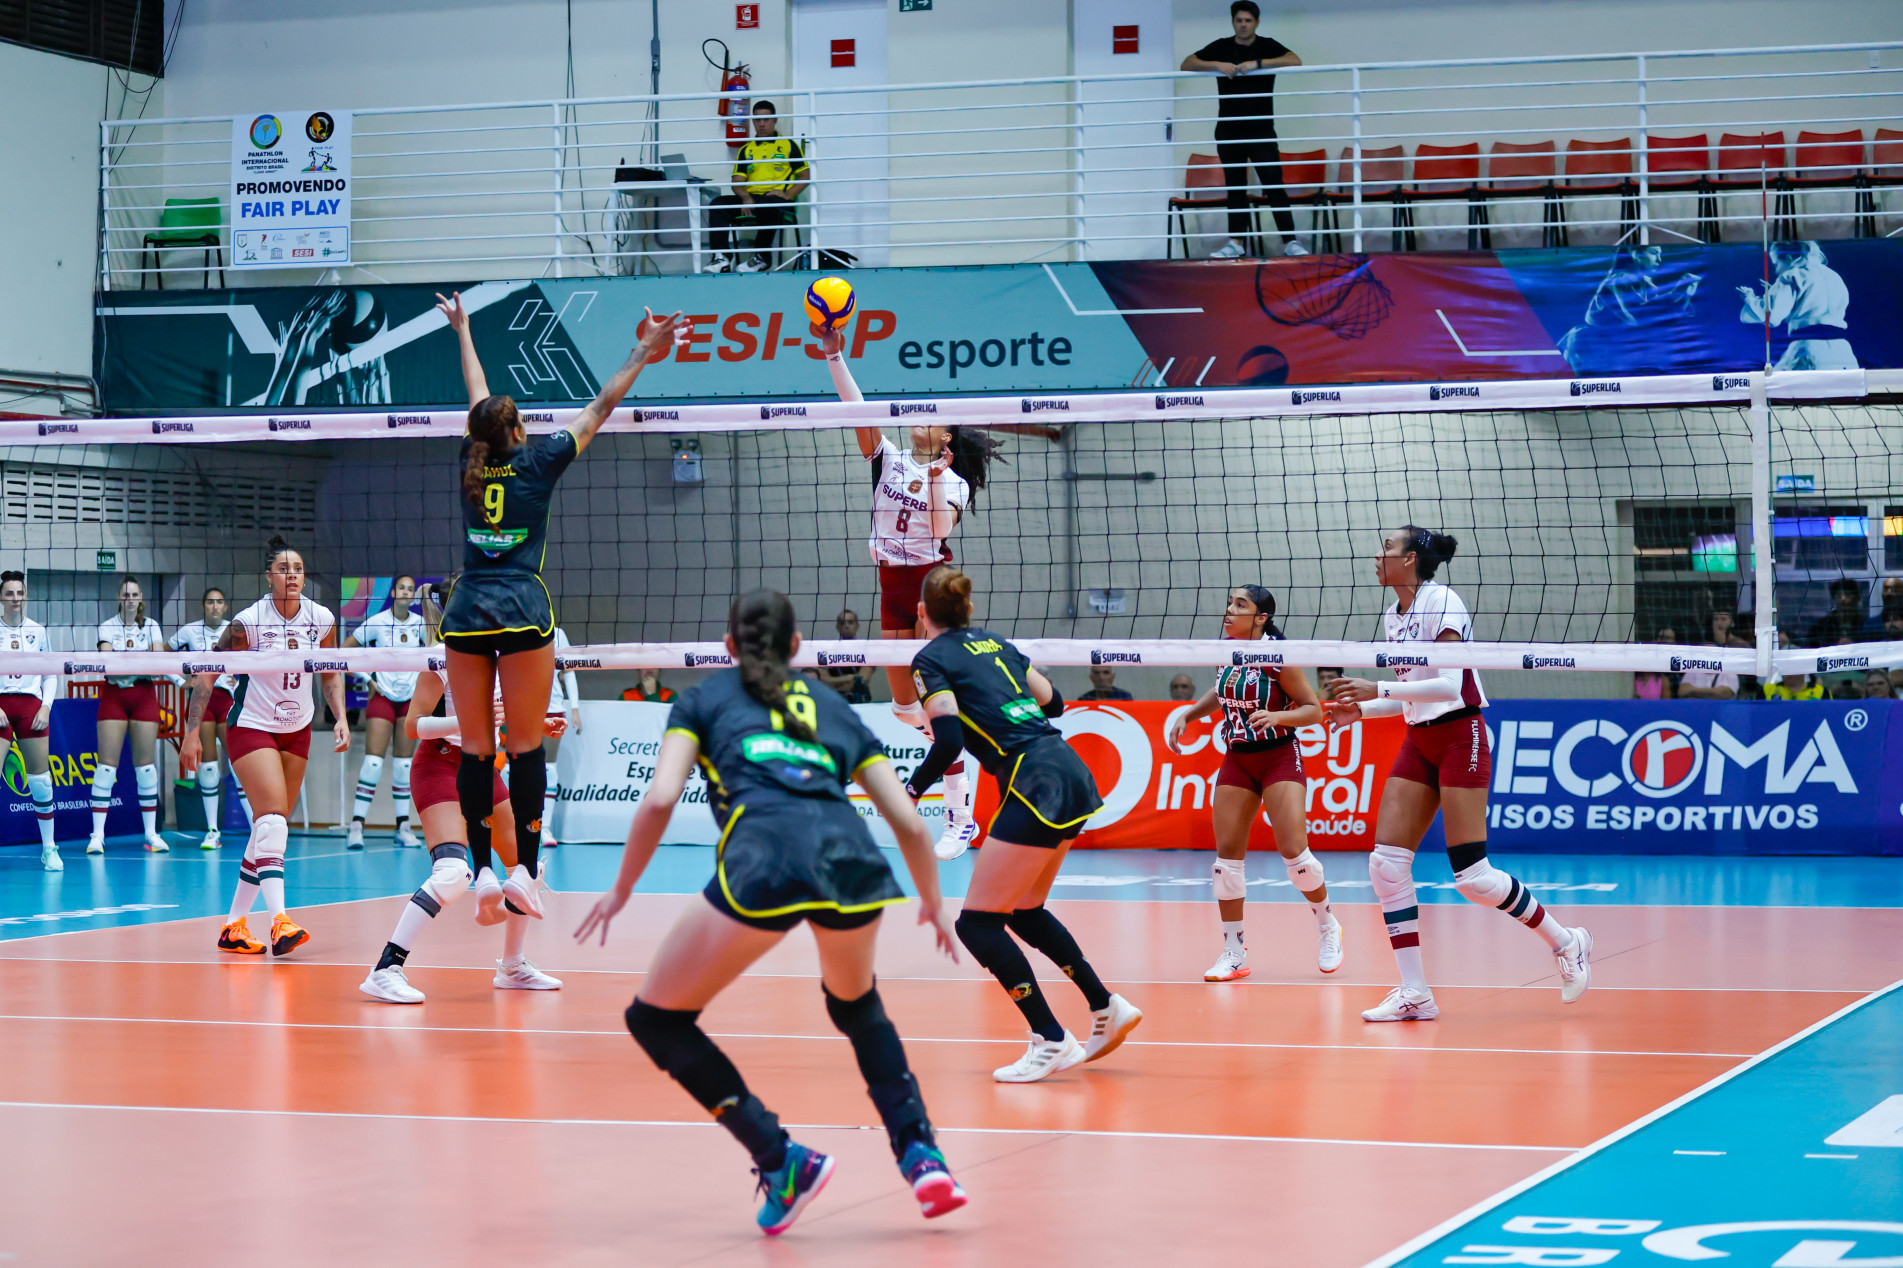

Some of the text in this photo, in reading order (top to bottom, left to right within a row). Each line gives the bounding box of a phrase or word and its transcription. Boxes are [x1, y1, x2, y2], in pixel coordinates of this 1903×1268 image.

[248, 150, 283, 158] PANATHLON
[236, 178, 346, 195] PROMOVENDO
[241, 199, 341, 218] FAIR PLAY
[293, 249, 314, 257] SESI
[899, 331, 1073, 379] esporte
[1581, 382, 1622, 394] SUPERLIGA
[1724, 378, 1750, 389] SUPER
[1302, 391, 1341, 403] SUPERLIGA
[1441, 386, 1480, 398] SUPERLIGA
[1032, 400, 1070, 411] SUPERLIGA
[1166, 396, 1204, 408] SUPERLIGA
[770, 406, 807, 417] SUPERLIGA
[900, 403, 937, 415] SUPERLIGA
[397, 415, 431, 426] SUPERLIGA
[522, 413, 554, 424] UPERLIGA
[643, 411, 679, 422] SUPERLIGA
[47, 424, 79, 435] SUPERLIGA
[161, 422, 194, 433] SUPERLIGA
[278, 420, 311, 430] SUPERLIGA
[484, 483, 505, 524] 9
[882, 484, 929, 511] SUPERB
[895, 509, 912, 533] 8
[97, 554, 115, 565] SAÍDA
[564, 658, 602, 669] SUPERLIGA
[695, 655, 733, 666] SUPERLIGA
[828, 653, 866, 665] SUPERLIGA
[1102, 652, 1141, 664] SUPERLIGA
[1243, 654, 1284, 666] SUPERLIGA
[1387, 656, 1429, 668] SUPERLIGA
[1534, 656, 1576, 668] SUPERLIGA
[1828, 657, 1869, 669] SUPERLIGA
[73, 664, 107, 674] SUPERLIGA
[191, 663, 226, 674] SUPERLIGA
[313, 662, 349, 672] SUPERLIGA
[1682, 659, 1723, 671] SUPERLIGA
[994, 656, 1022, 694] 1
[282, 672, 302, 691] 13
[1163, 704, 1363, 776] Cerj
[1470, 719, 1480, 762] FLUMINENSE
[608, 737, 664, 756] Secret
[1487, 718, 1860, 799] ECOMA
[57, 800, 89, 811] BRASILEIRA
[1485, 804, 1819, 831] ISOS ESPORTIVOS
